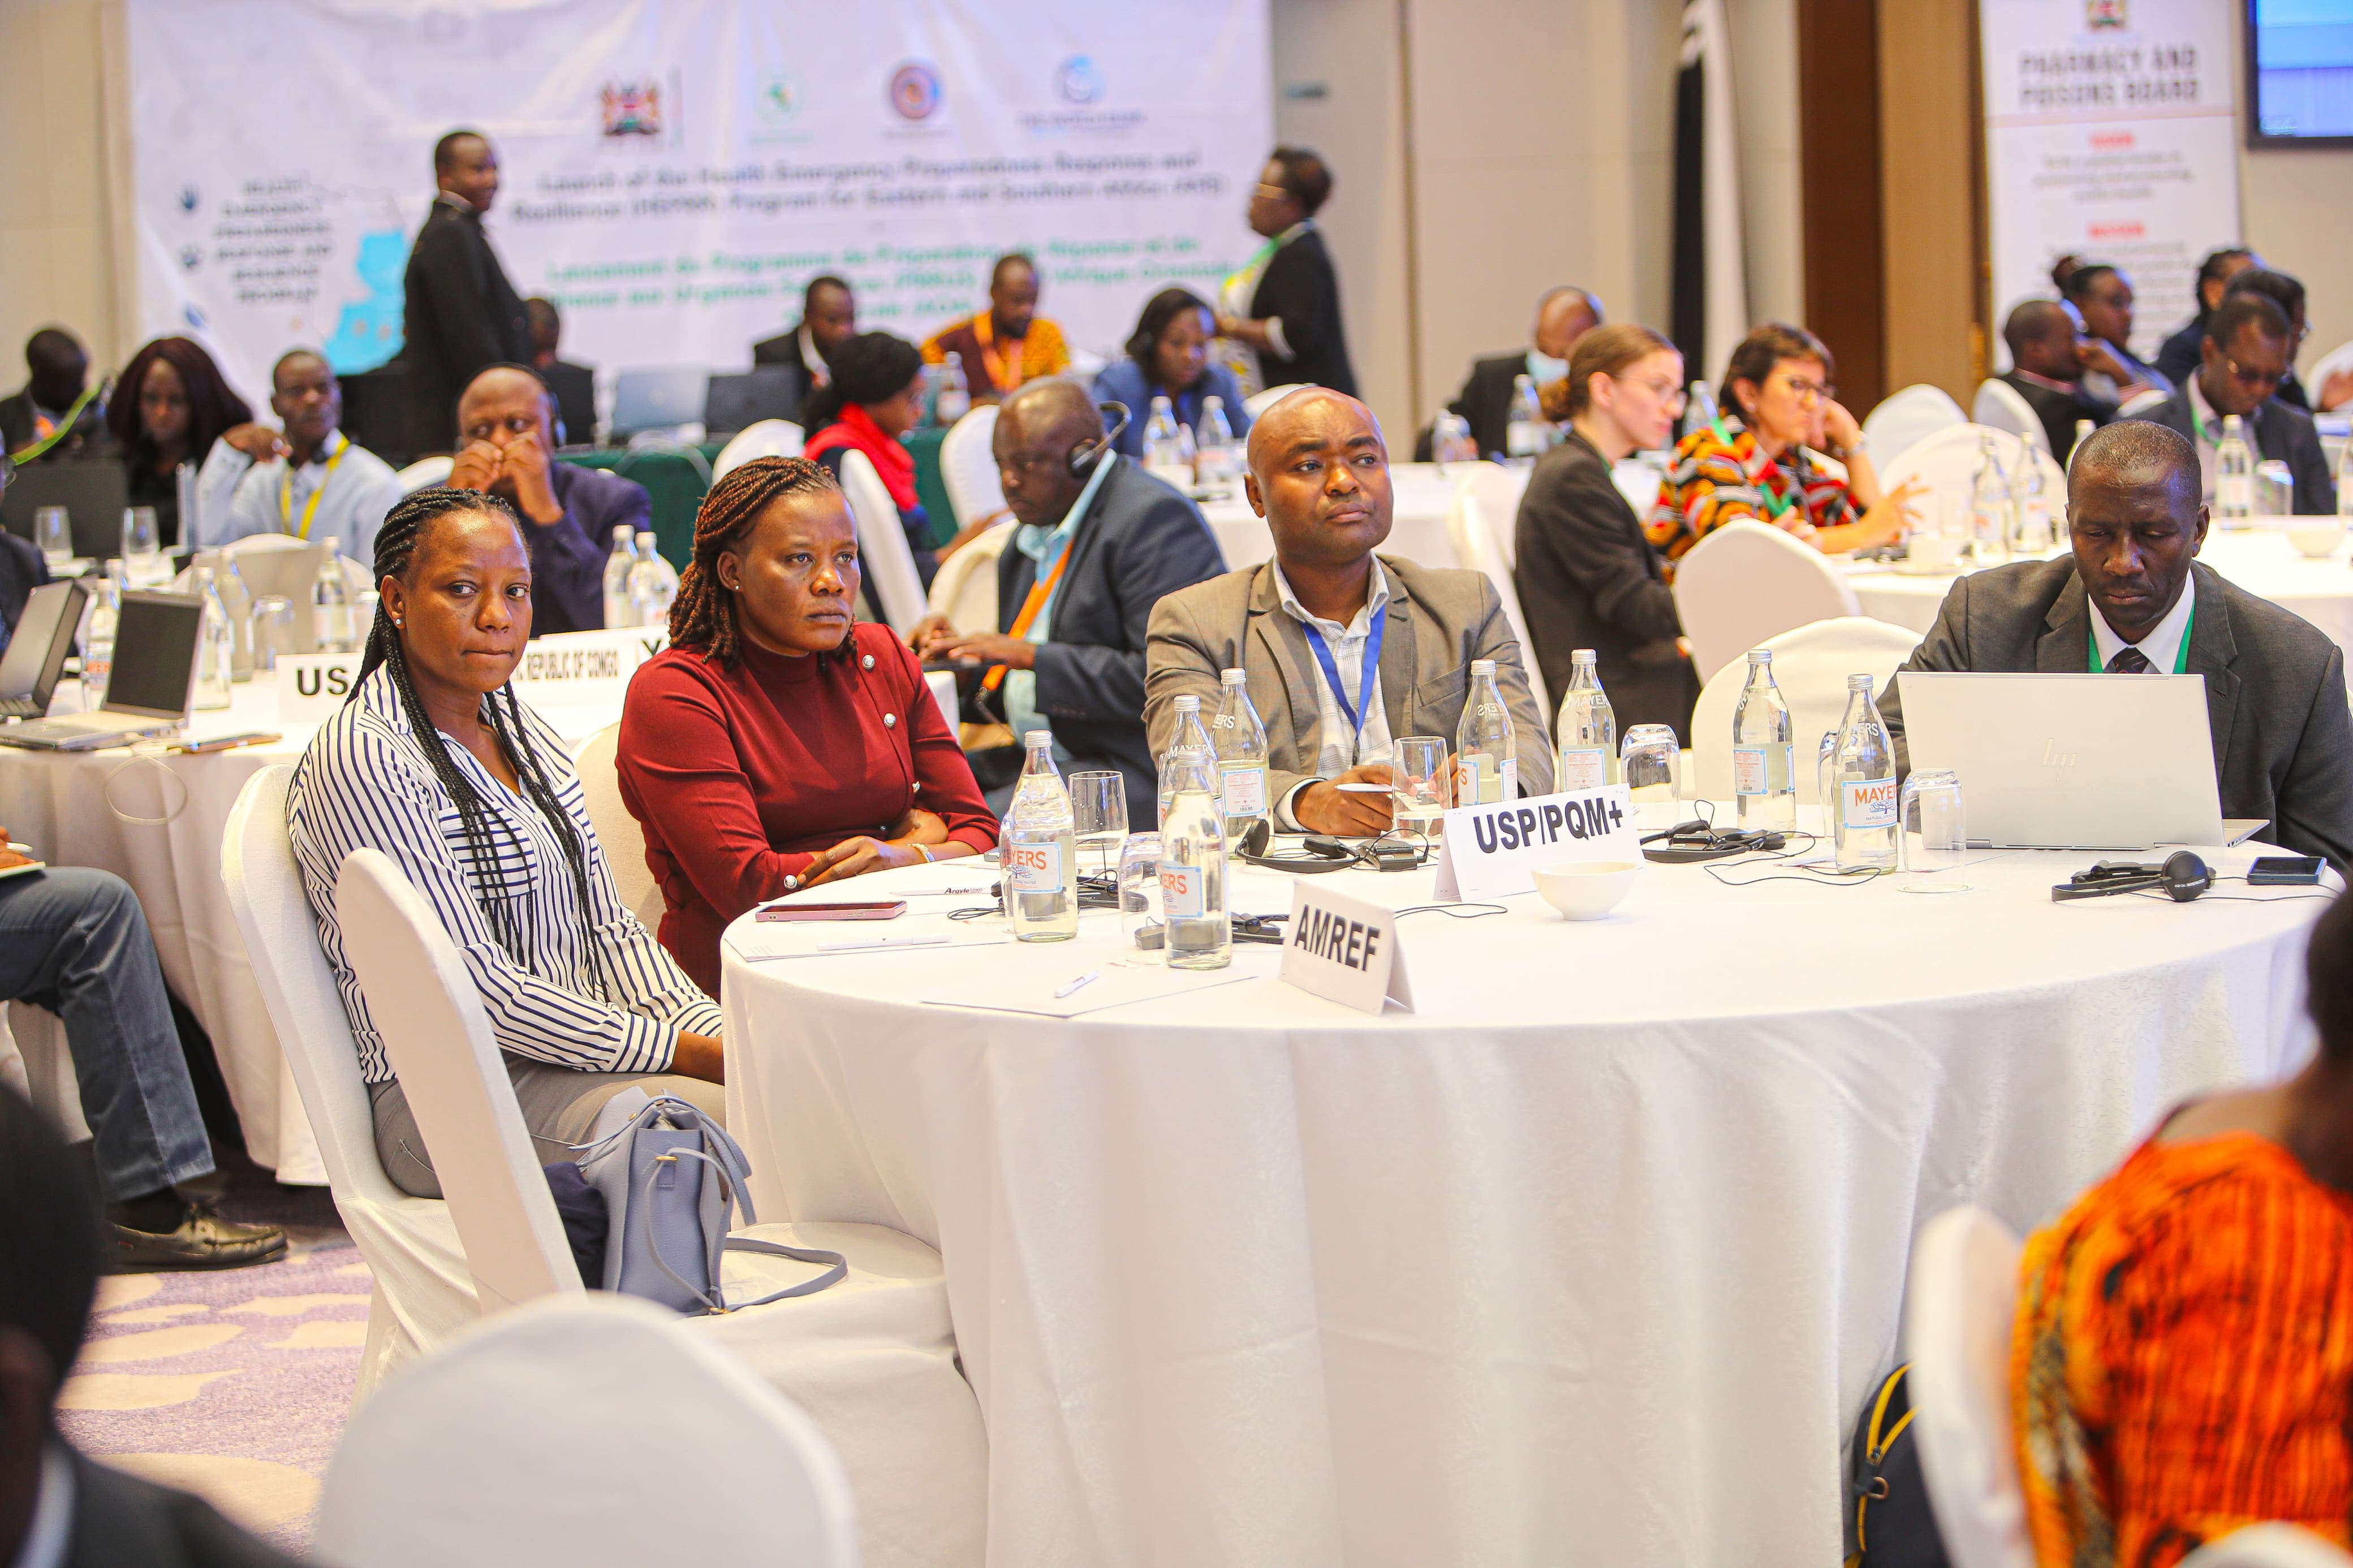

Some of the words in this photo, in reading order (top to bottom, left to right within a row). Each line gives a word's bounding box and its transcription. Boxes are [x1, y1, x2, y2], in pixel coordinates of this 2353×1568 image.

[2153, 44, 2197, 71] AND
[527, 651, 570, 680] REPUBLIC
[574, 650, 584, 679] OF
[587, 649, 618, 677] CONGO
[1473, 794, 1624, 854] USP/PQM+
[1294, 904, 1381, 973] AMREF
